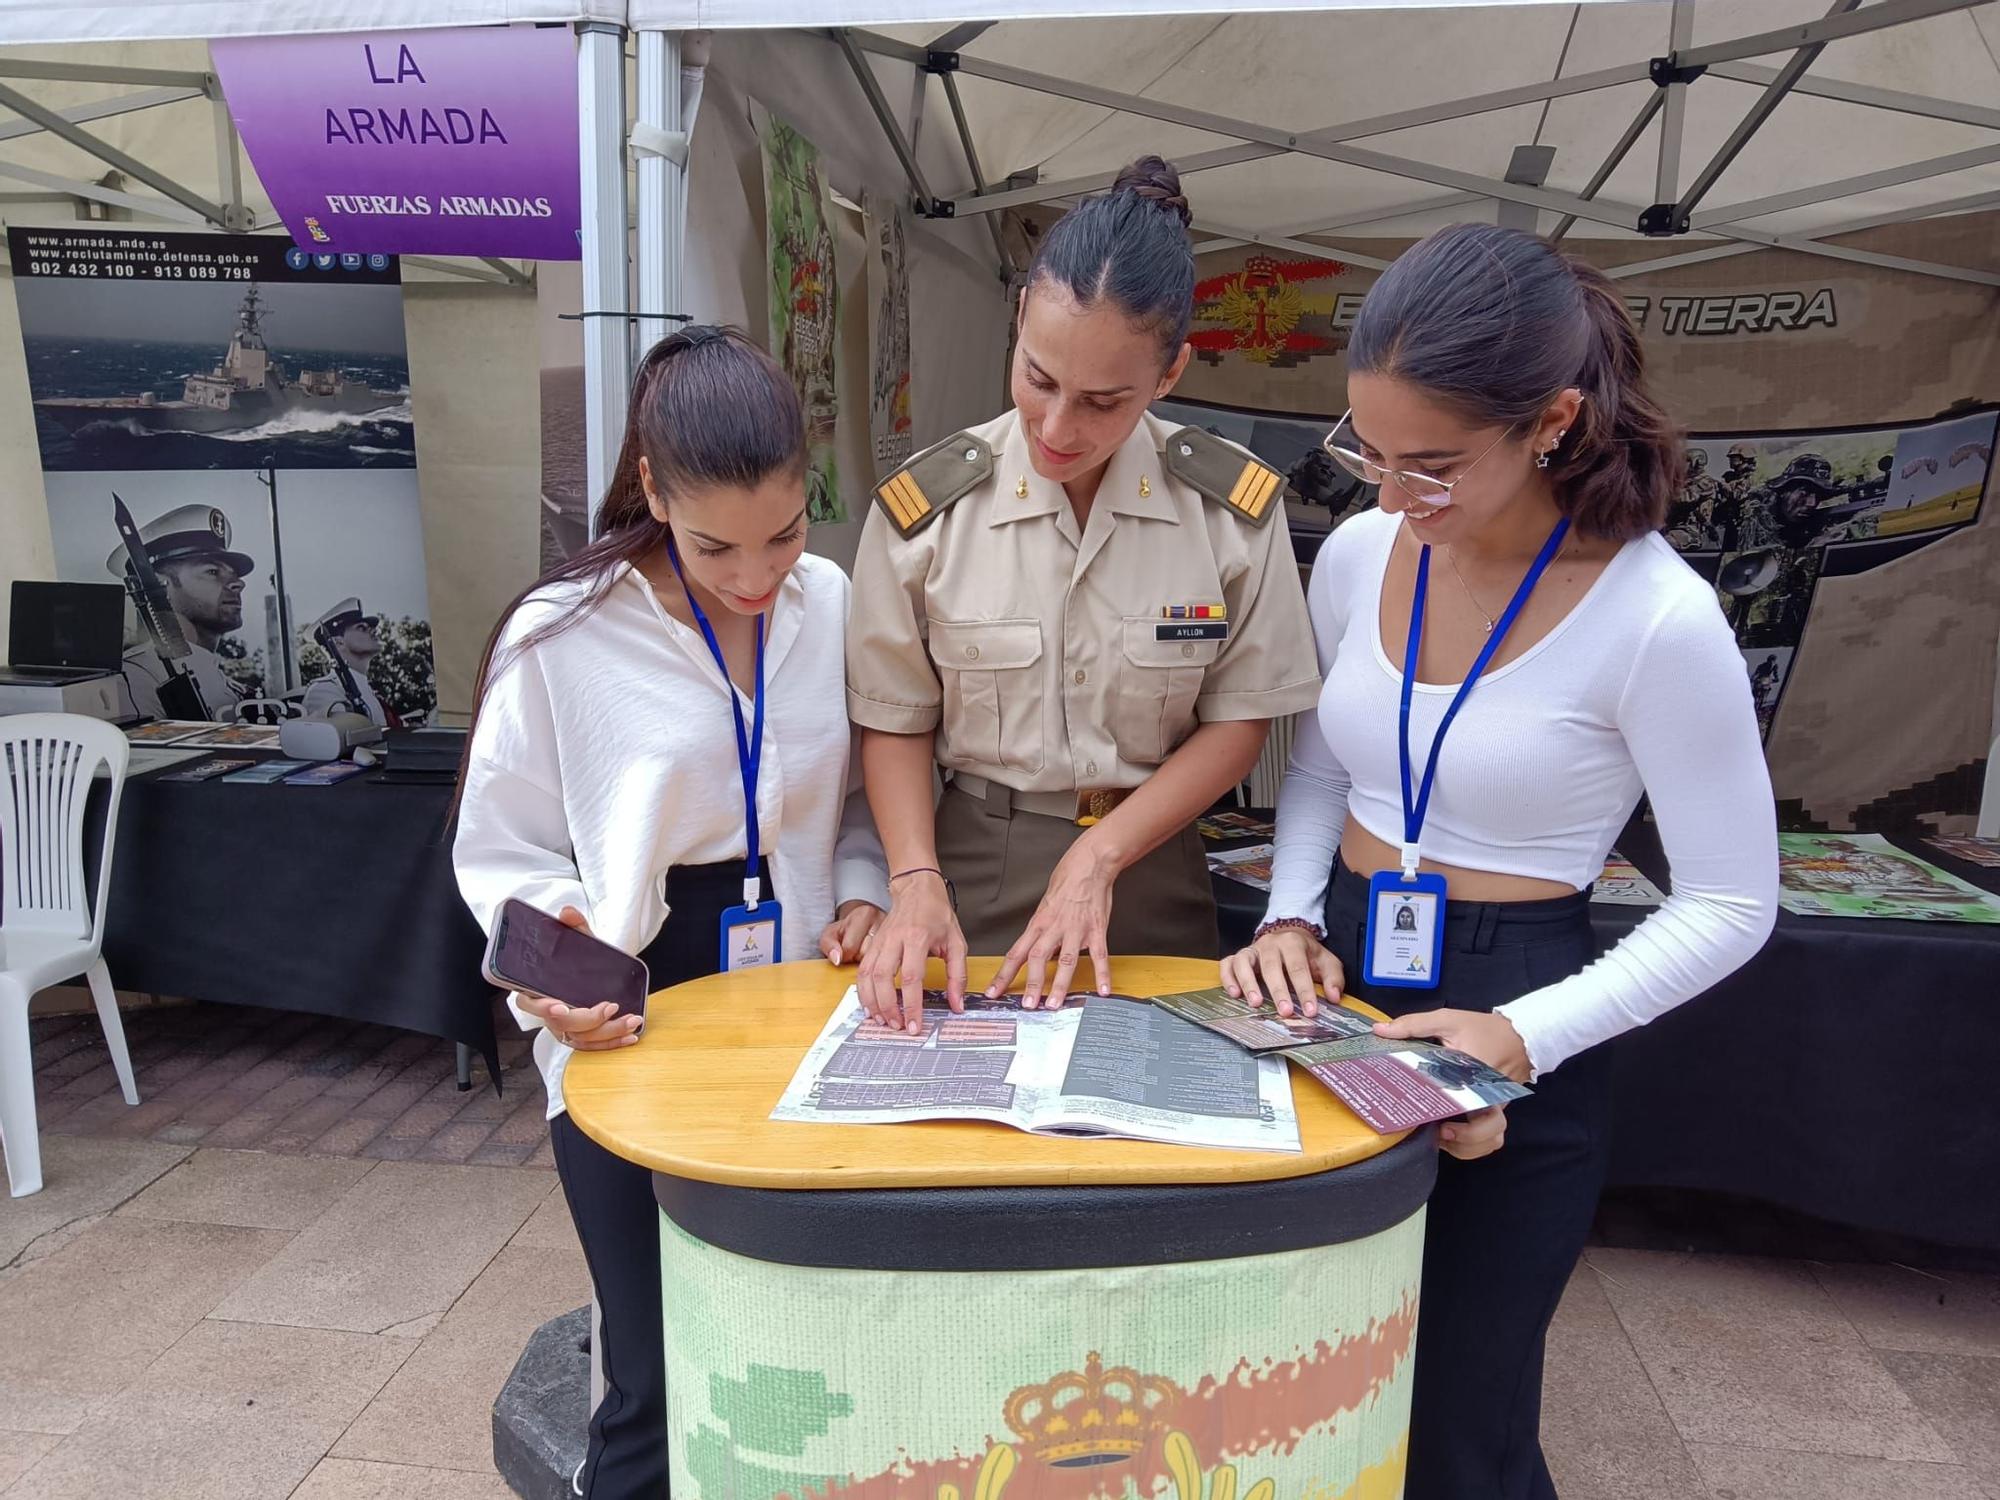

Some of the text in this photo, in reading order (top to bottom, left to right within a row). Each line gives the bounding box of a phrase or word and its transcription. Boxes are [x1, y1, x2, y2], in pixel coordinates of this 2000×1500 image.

[364, 43, 426, 84] LA
[325, 108, 509, 145] ARMADA
[325, 195, 552, 217] FUERZAS ARMADAS
[28, 236, 166, 249] www.armada.mde.es
[29, 249, 259, 265] www.reclutamiento.defensa.gob.es
[31, 261, 61, 275] 902
[68, 263, 98, 276] 432
[105, 264, 134, 277] 100
[154, 265, 182, 278] 913
[189, 266, 217, 279] 089
[223, 266, 251, 279] 798
[1660, 289, 1837, 334] TIERRA
